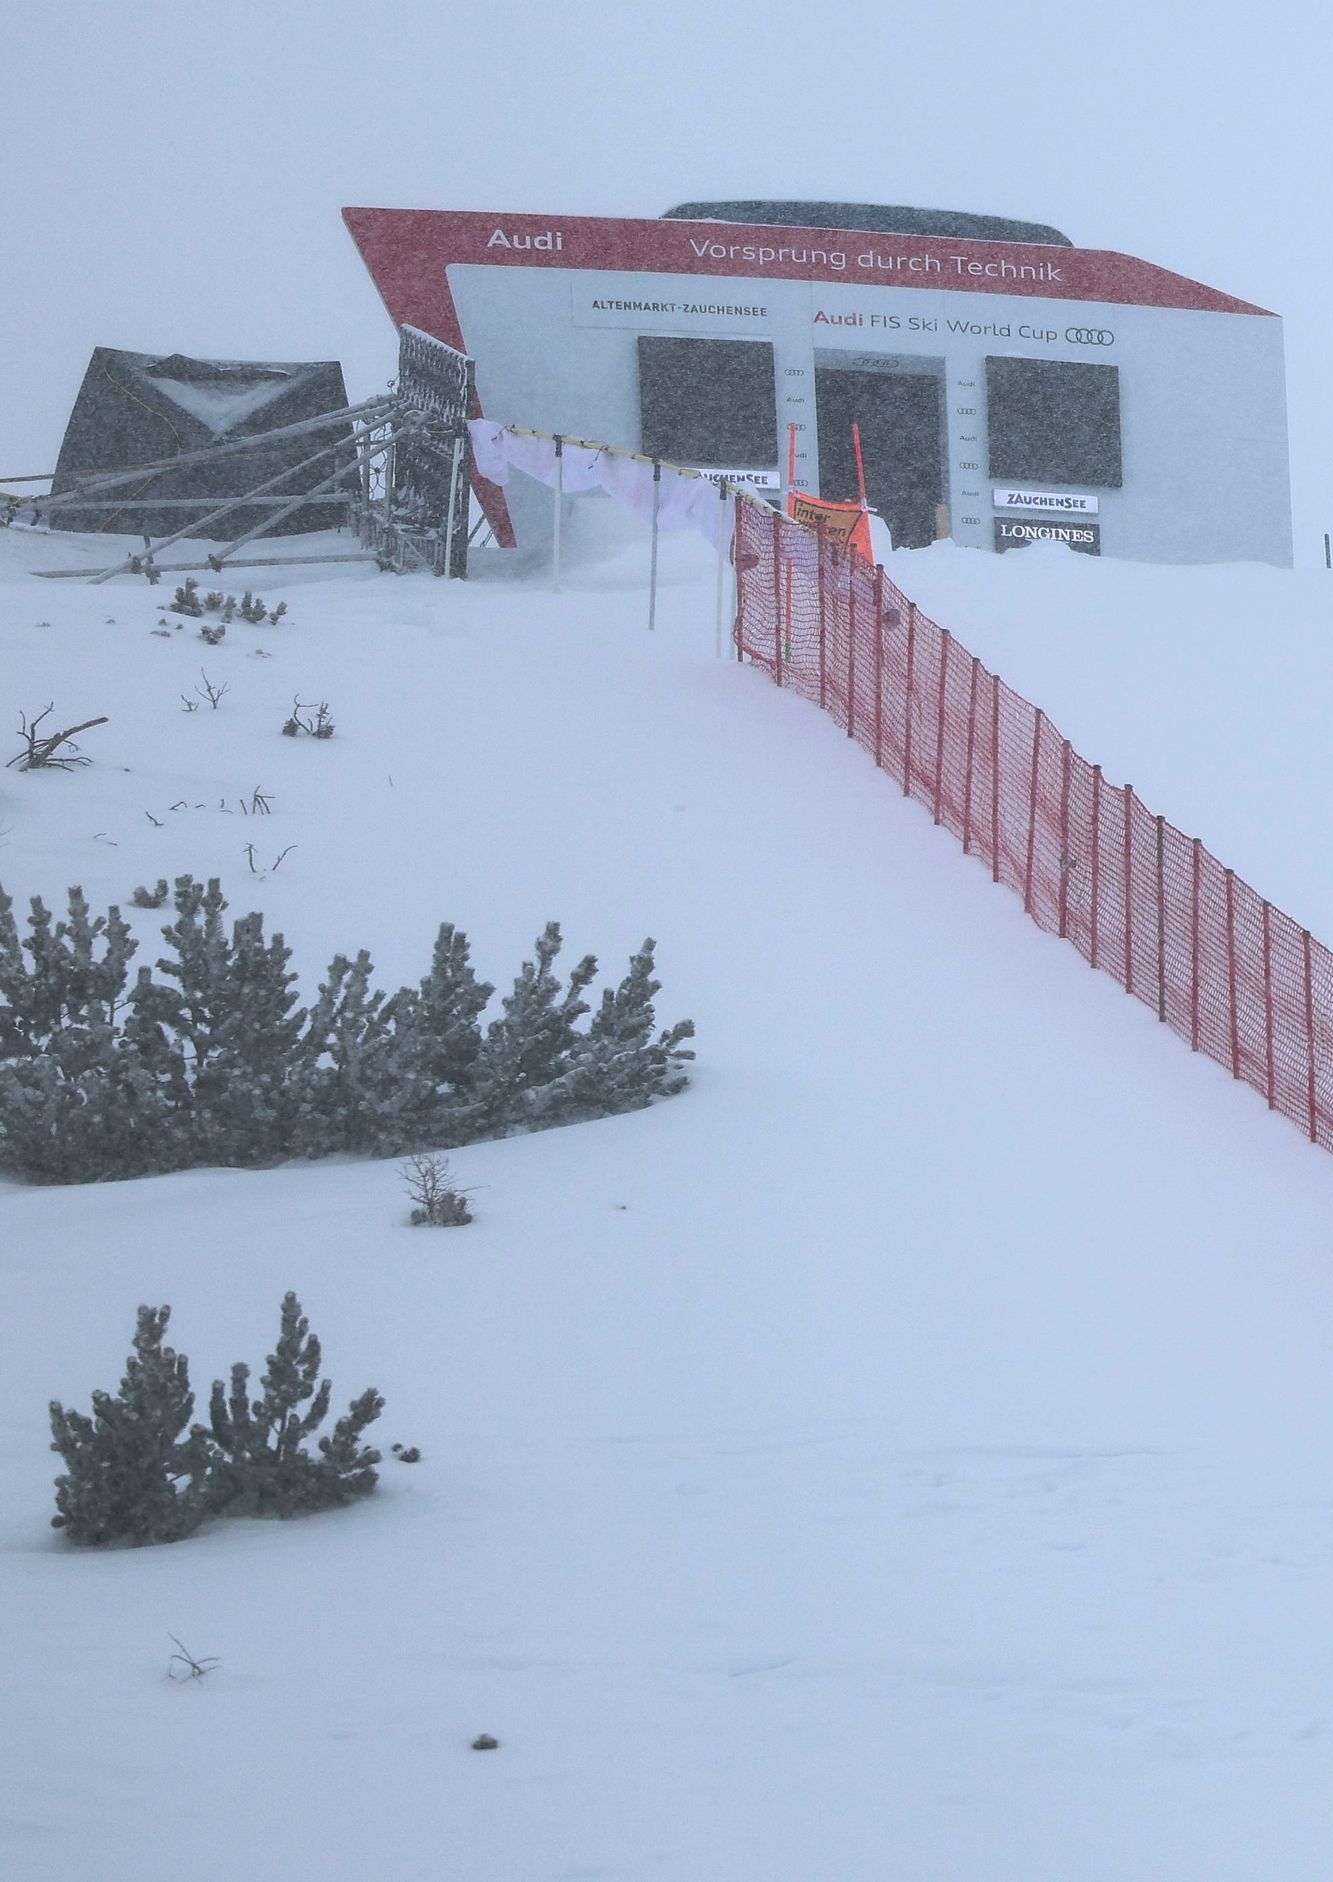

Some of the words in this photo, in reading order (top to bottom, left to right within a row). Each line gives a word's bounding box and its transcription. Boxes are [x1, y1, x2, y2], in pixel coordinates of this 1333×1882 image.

[486, 229, 563, 250] Audi
[689, 238, 847, 271] Vorsprung
[857, 249, 942, 273] durch
[949, 256, 1063, 282] Technik
[592, 300, 768, 317] ALTENMARKT-ZAUCHENSEE
[813, 310, 864, 328] Audi
[870, 313, 902, 330] FIS
[907, 317, 939, 333] Ski
[946, 319, 1012, 339] World
[1018, 325, 1059, 342] Cup
[1006, 493, 1087, 509] ZAUCHENSEE
[1000, 524, 1095, 543] LONGINES
